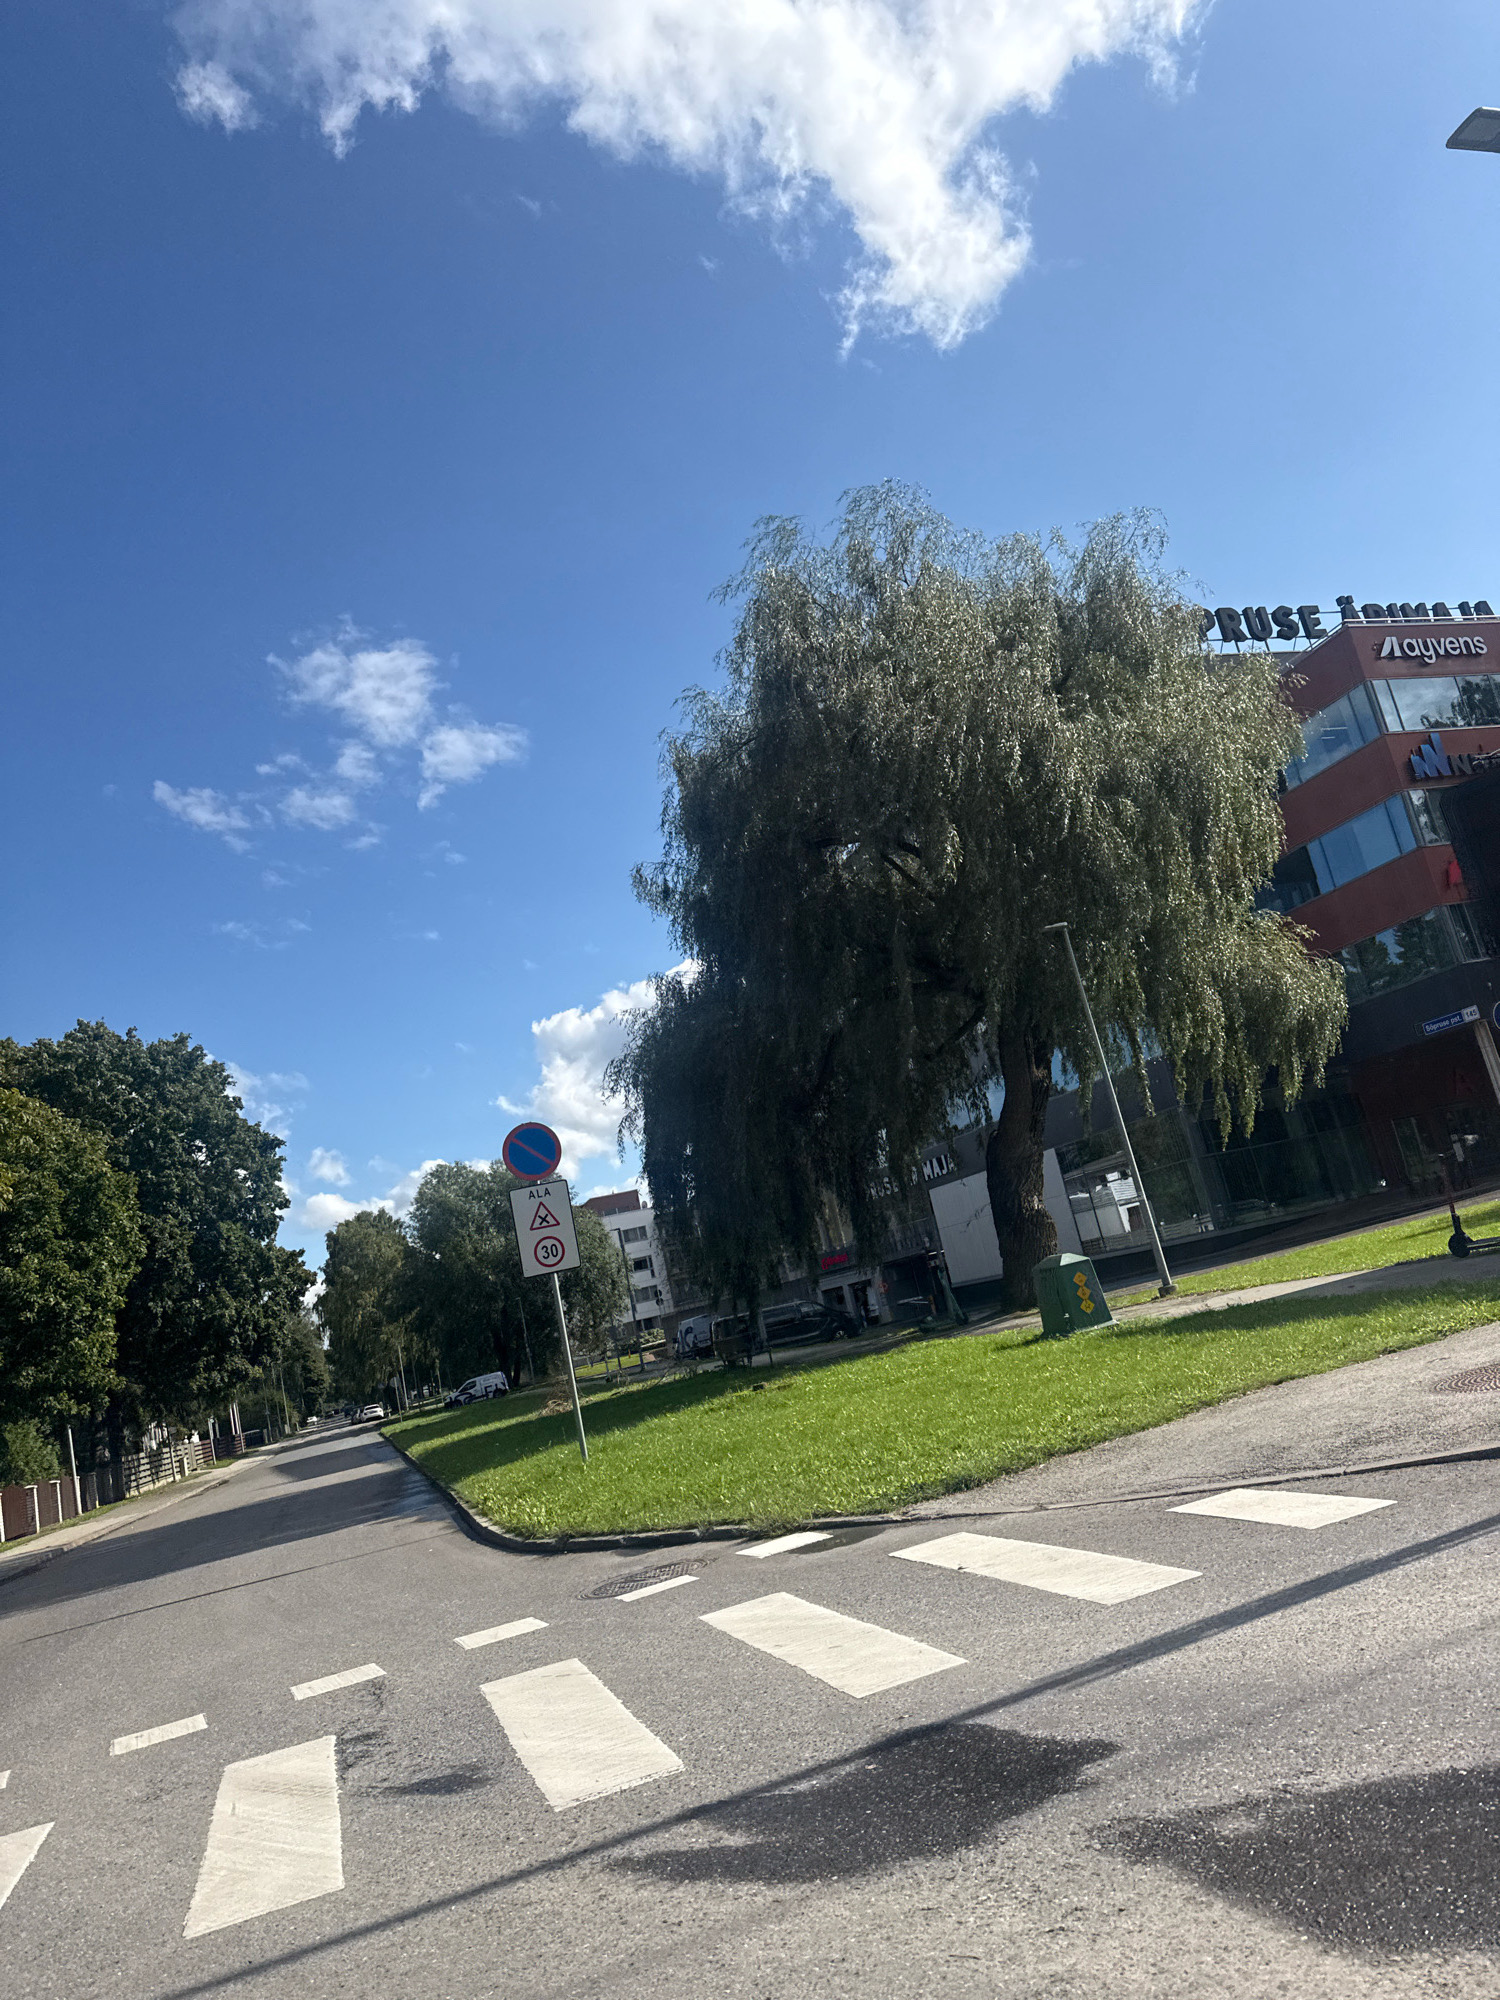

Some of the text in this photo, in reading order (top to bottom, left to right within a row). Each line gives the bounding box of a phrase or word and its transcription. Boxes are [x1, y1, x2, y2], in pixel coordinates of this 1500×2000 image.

[1402, 636, 1488, 664] ayvens
[1465, 1009, 1478, 1018] 145
[528, 1187, 552, 1200] ALA
[541, 1243, 559, 1260] 30
